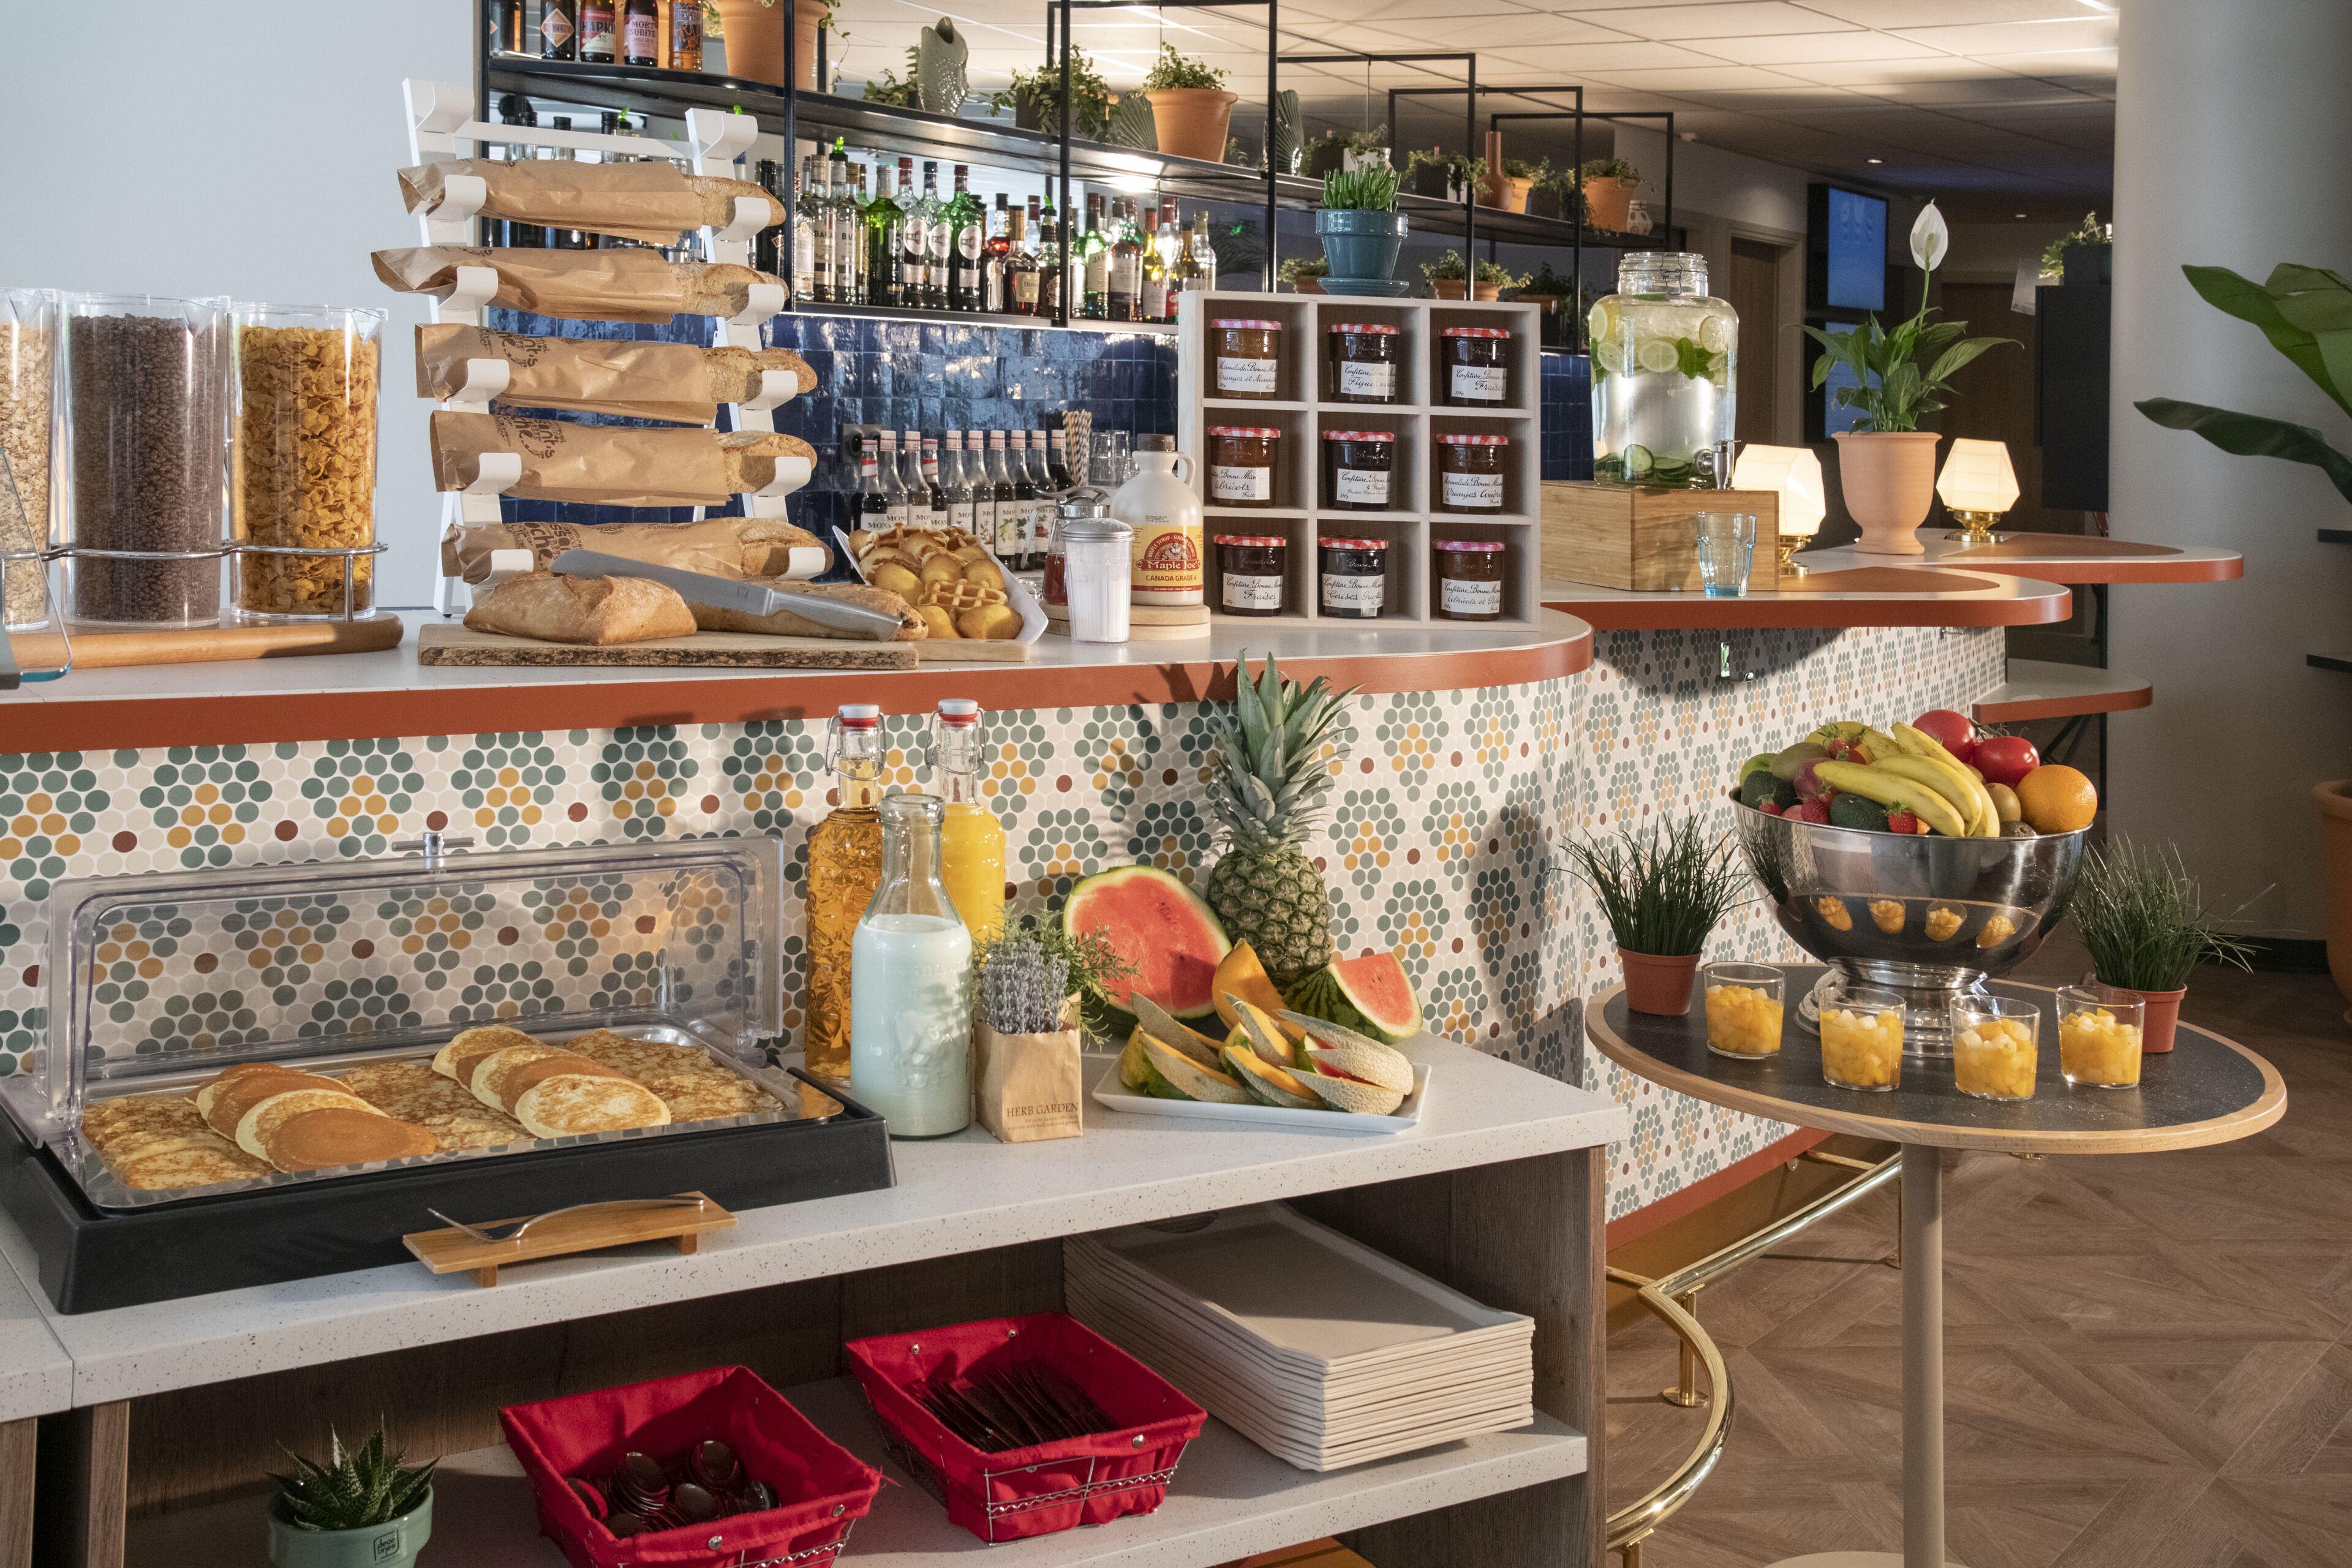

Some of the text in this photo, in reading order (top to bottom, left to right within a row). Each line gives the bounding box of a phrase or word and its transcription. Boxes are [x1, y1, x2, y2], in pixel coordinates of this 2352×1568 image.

[629, 28, 656, 37] SUBITE
[1248, 361, 1266, 372] Bonne
[1345, 364, 1370, 377] Confiture
[1457, 368, 1481, 380] Confiture
[1221, 468, 1240, 478] Bonne
[1341, 470, 1366, 484] Confiture
[1215, 480, 1251, 491] Abricots
[1470, 477, 1490, 486] Bonne
[1446, 488, 1477, 500] Oranges
[1147, 543, 1158, 558] MAPLE
[1156, 535, 1170, 546] SYRUP
[1147, 560, 1196, 571] Maple Joe
[1226, 576, 1251, 589] Confiture
[1252, 578, 1272, 588] Bonne
[1324, 576, 1347, 589] Confiture
[1348, 578, 1368, 589] Bonne
[1444, 581, 1468, 594] Confiture
[1470, 584, 1490, 594] Bonne
[1244, 589, 1276, 600] Fraises
[1327, 590, 1359, 600] Cerises
[1447, 595, 1476, 605] Abricots
[1006, 1103, 1078, 1117] HERB GARDEN
[377, 1537, 396, 1549] deco
